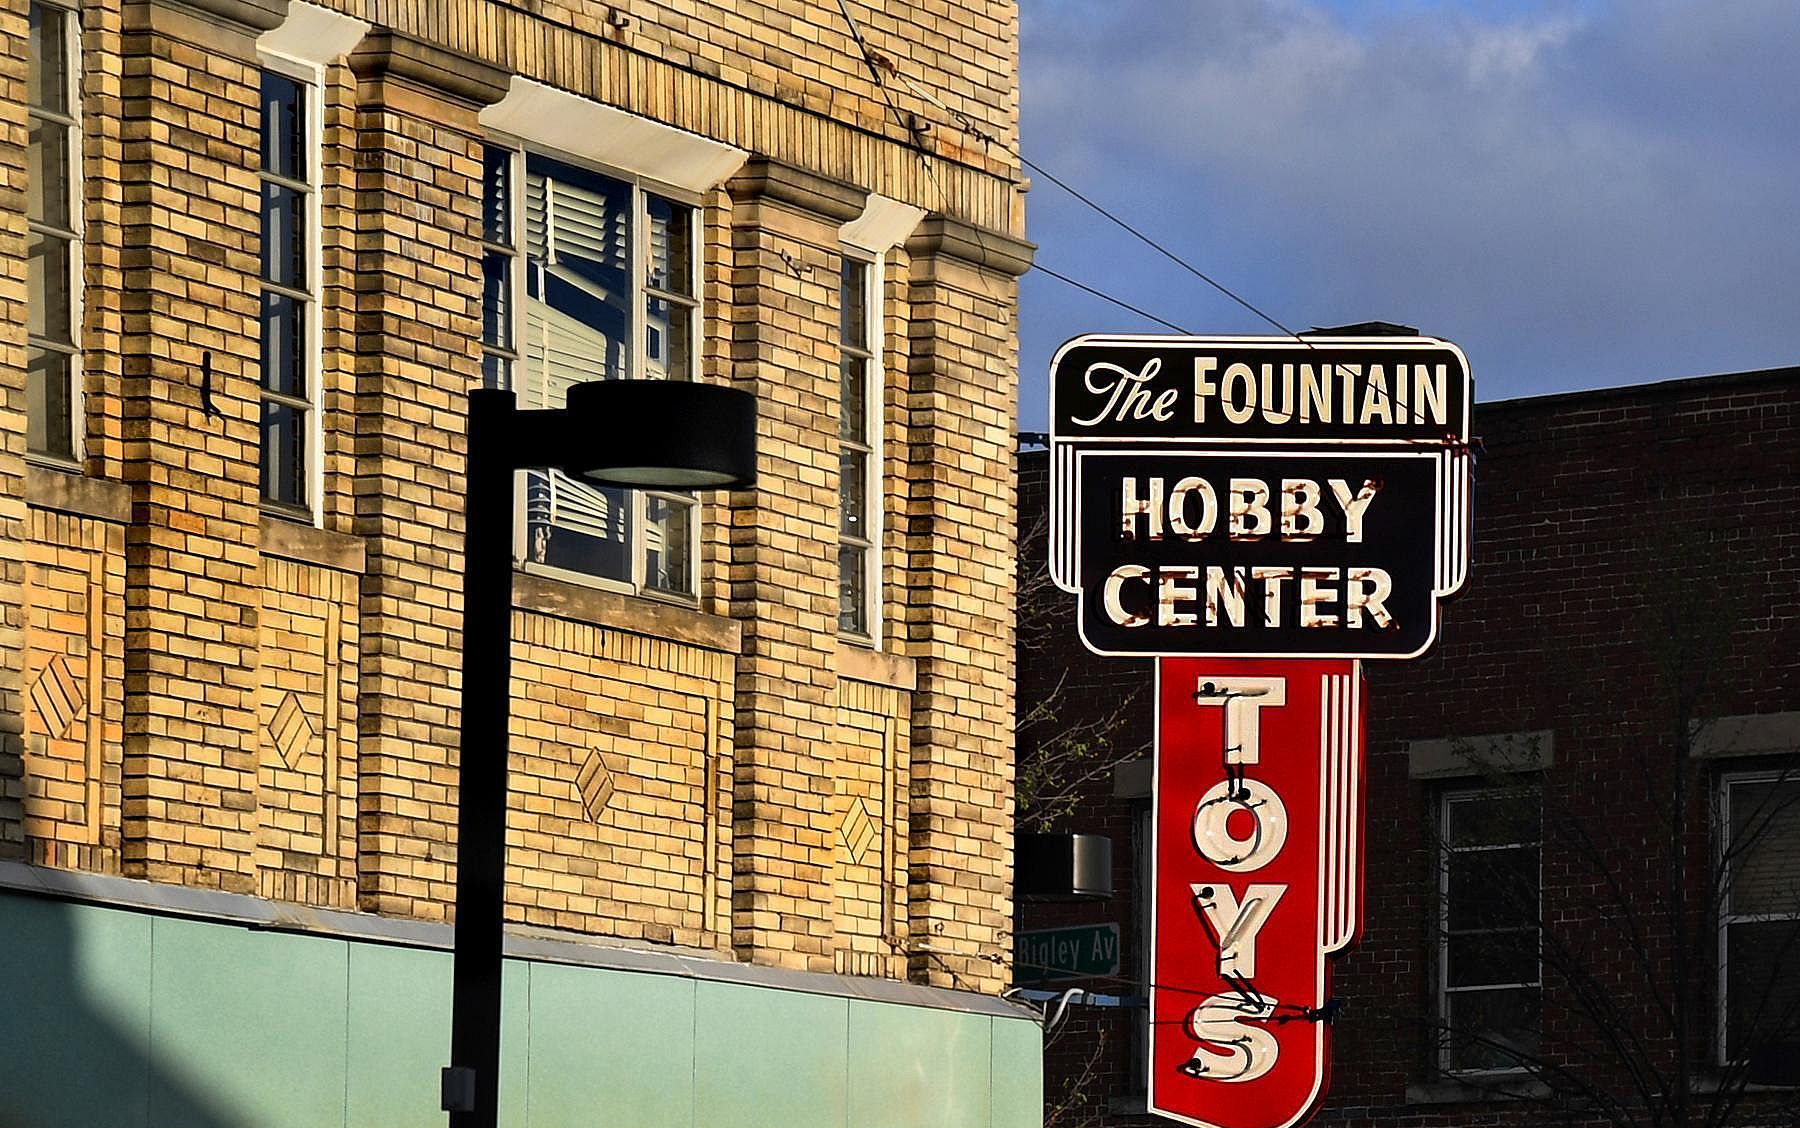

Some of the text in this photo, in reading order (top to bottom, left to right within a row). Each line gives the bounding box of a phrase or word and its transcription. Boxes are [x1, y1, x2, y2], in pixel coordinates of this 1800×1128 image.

[1071, 356, 1448, 427] The FOUNTAIN
[1120, 476, 1383, 544] HOBBY
[1102, 564, 1400, 629] CENTER
[1189, 675, 1289, 1083] TOYS
[1091, 929, 1114, 961] Av
